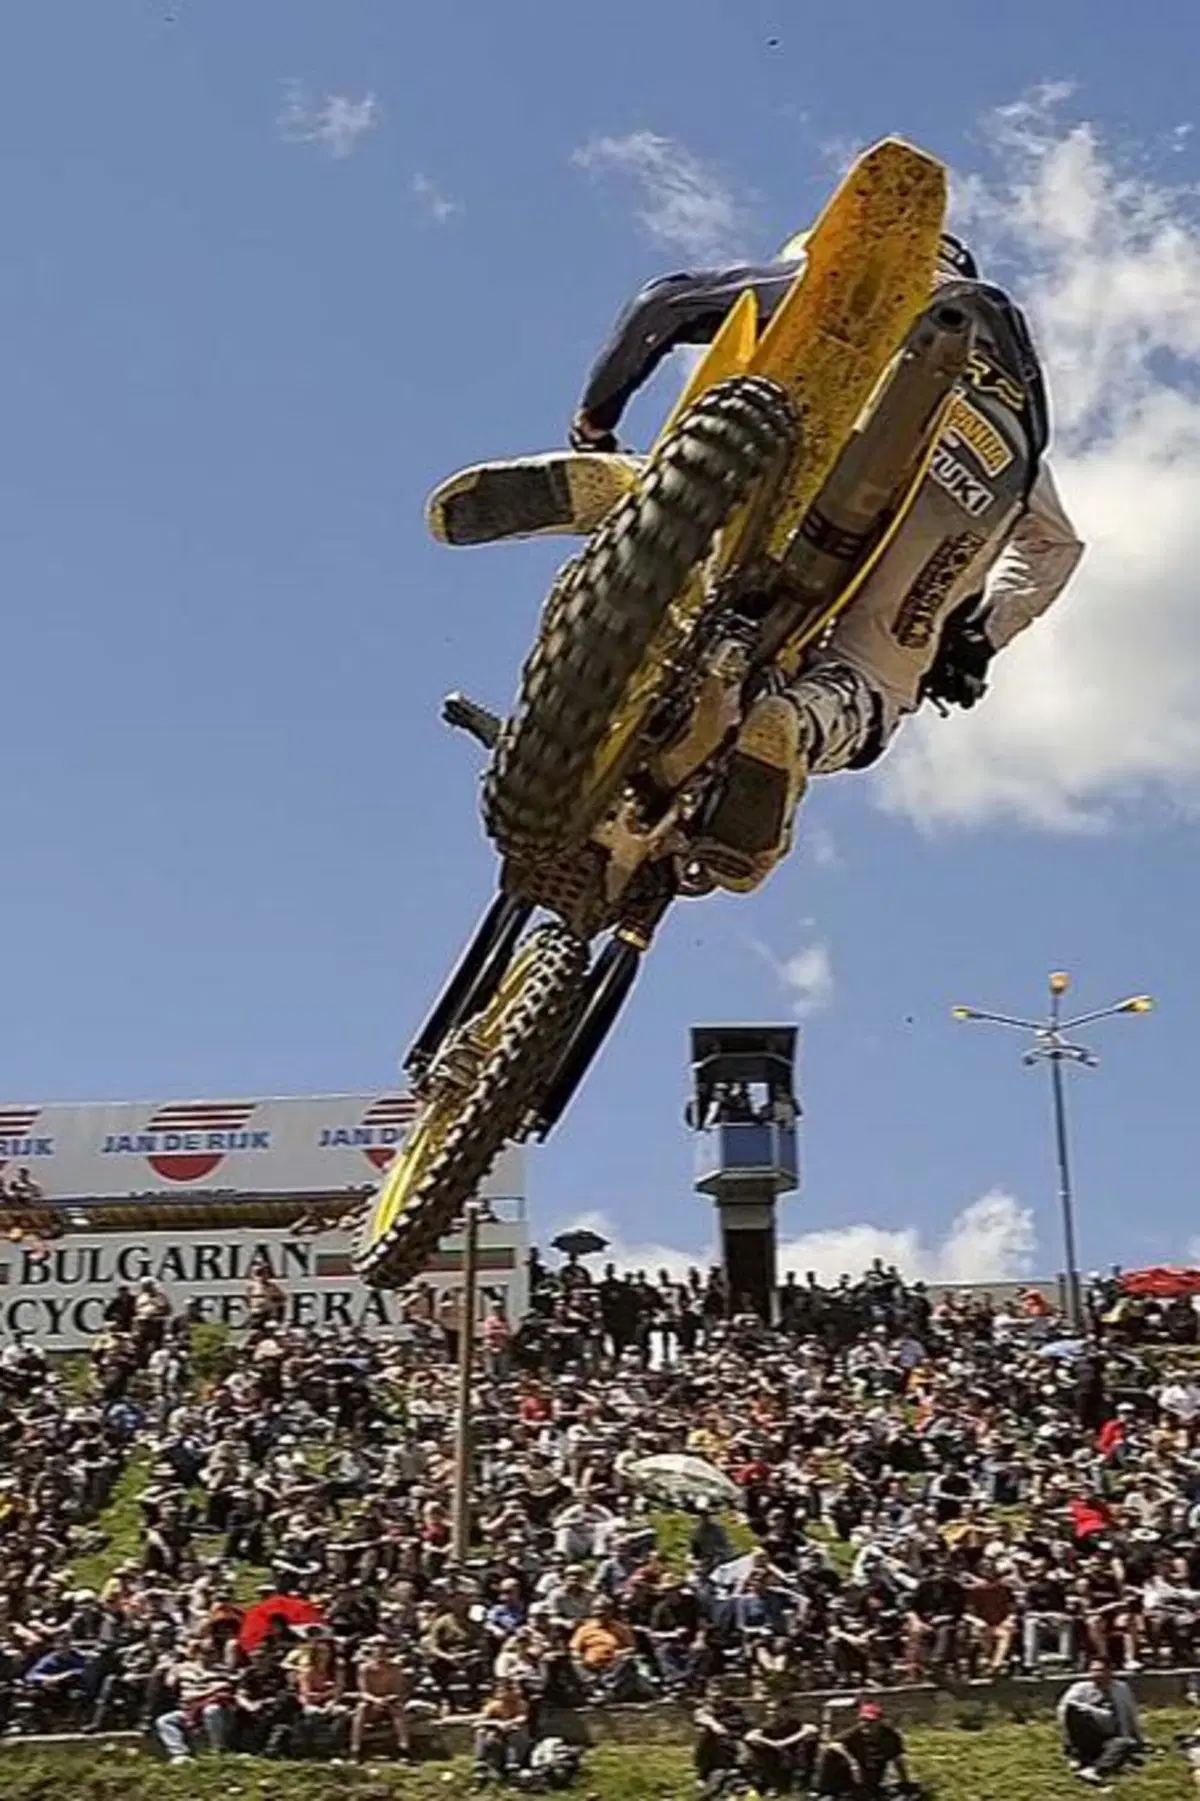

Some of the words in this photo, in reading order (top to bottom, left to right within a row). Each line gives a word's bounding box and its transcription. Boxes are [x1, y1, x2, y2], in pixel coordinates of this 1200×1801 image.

[102, 1134, 157, 1153] JAN
[164, 1133, 201, 1150] DE
[208, 1130, 270, 1150] RIJK
[318, 1127, 373, 1147] JAN
[381, 1127, 407, 1145] D
[20, 1242, 312, 1285] BULGARIAN
